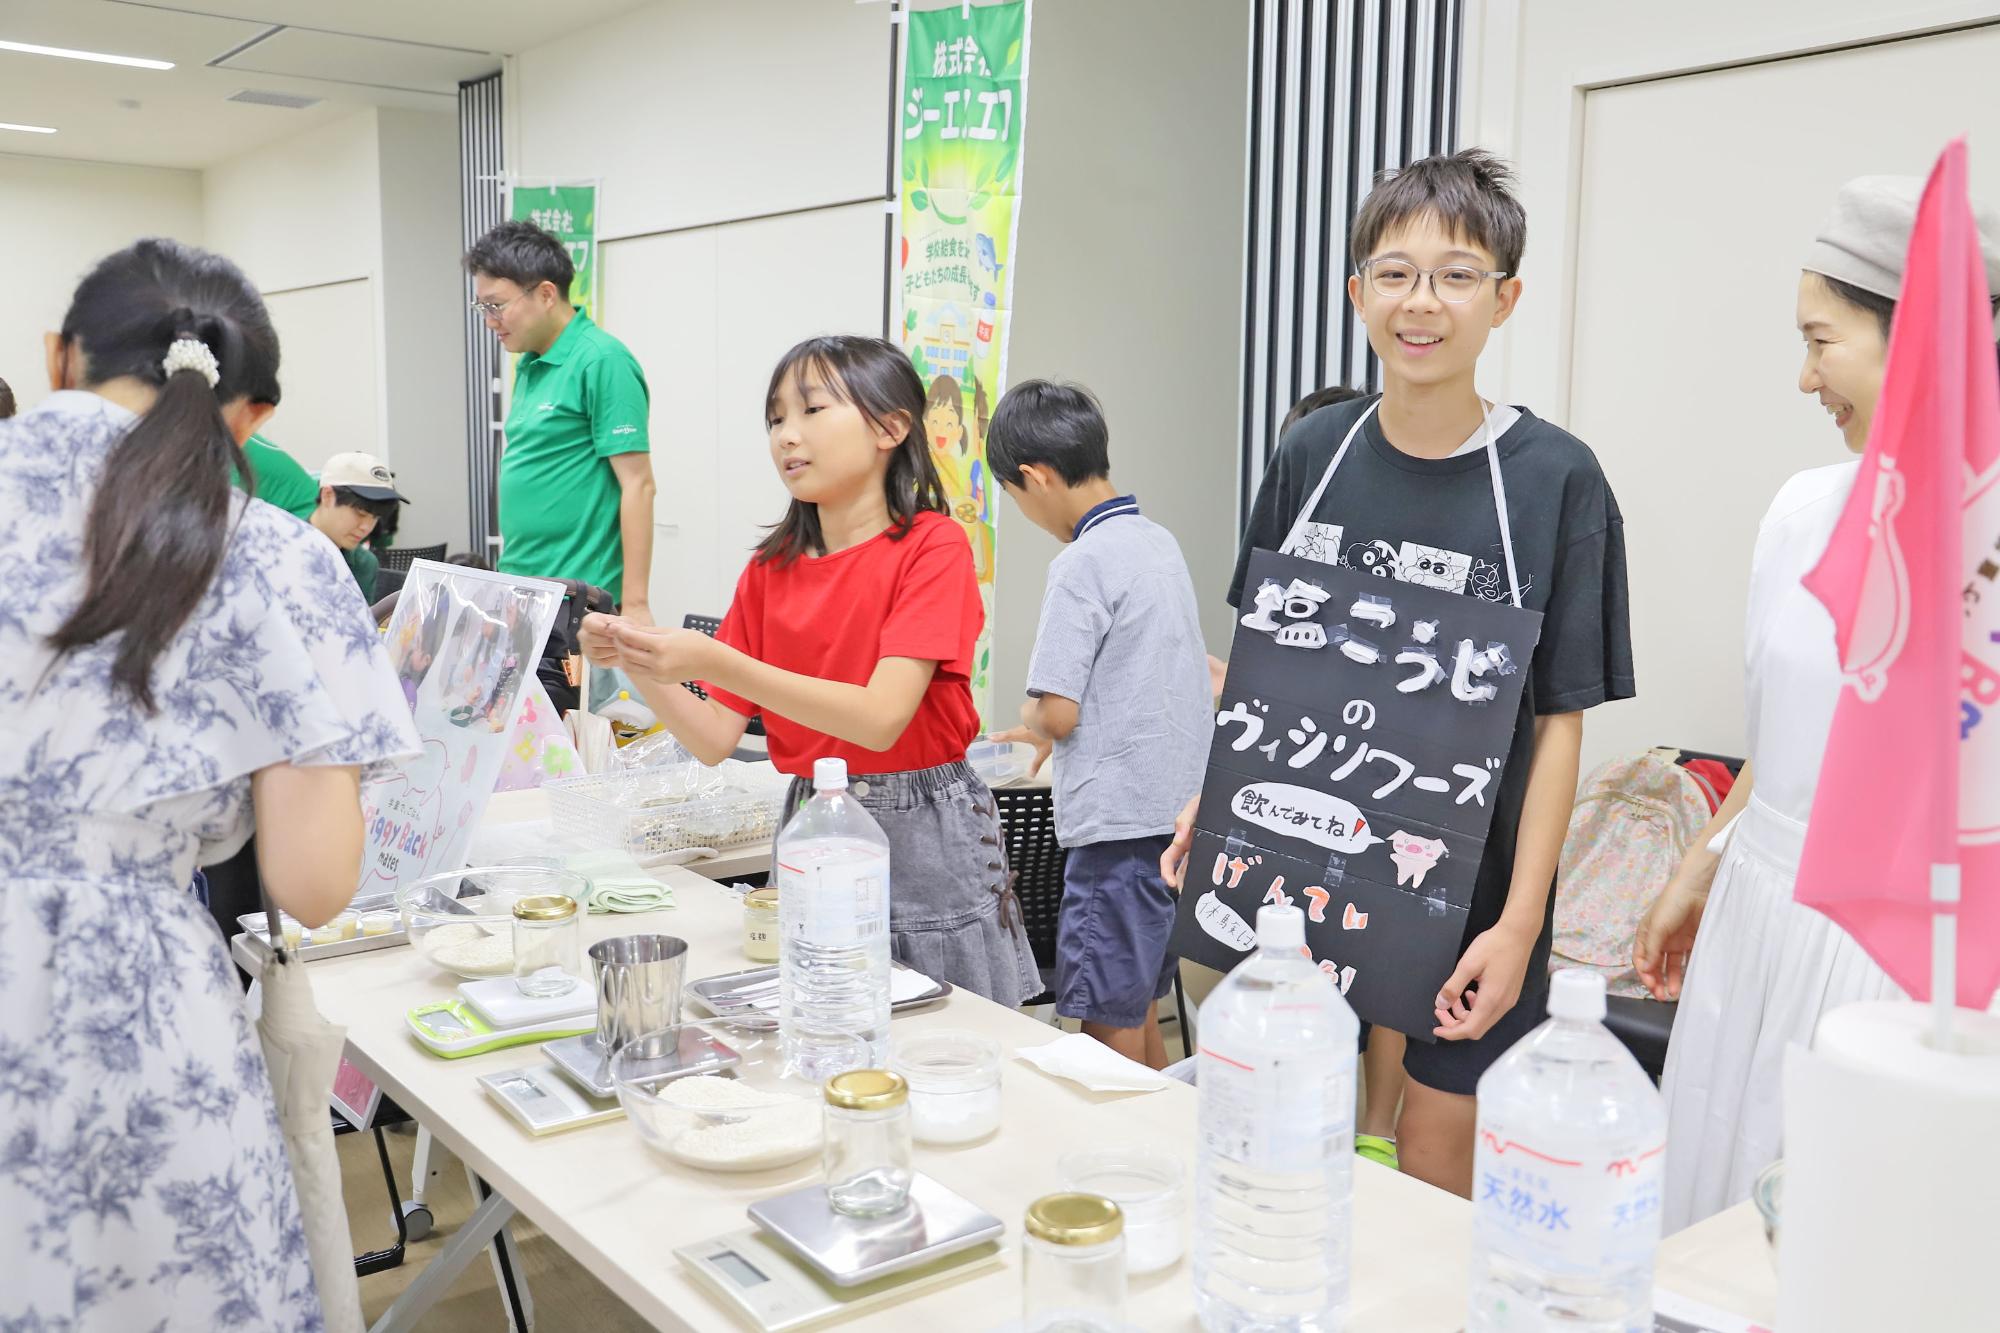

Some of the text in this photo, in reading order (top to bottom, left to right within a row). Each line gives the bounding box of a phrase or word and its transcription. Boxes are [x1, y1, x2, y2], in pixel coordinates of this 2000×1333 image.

[1343, 699, 1376, 730] の
[1216, 699, 1501, 807] ヴィシソワーズ
[397, 821, 428, 860] Back
[1482, 1171, 1571, 1231] 天然水
